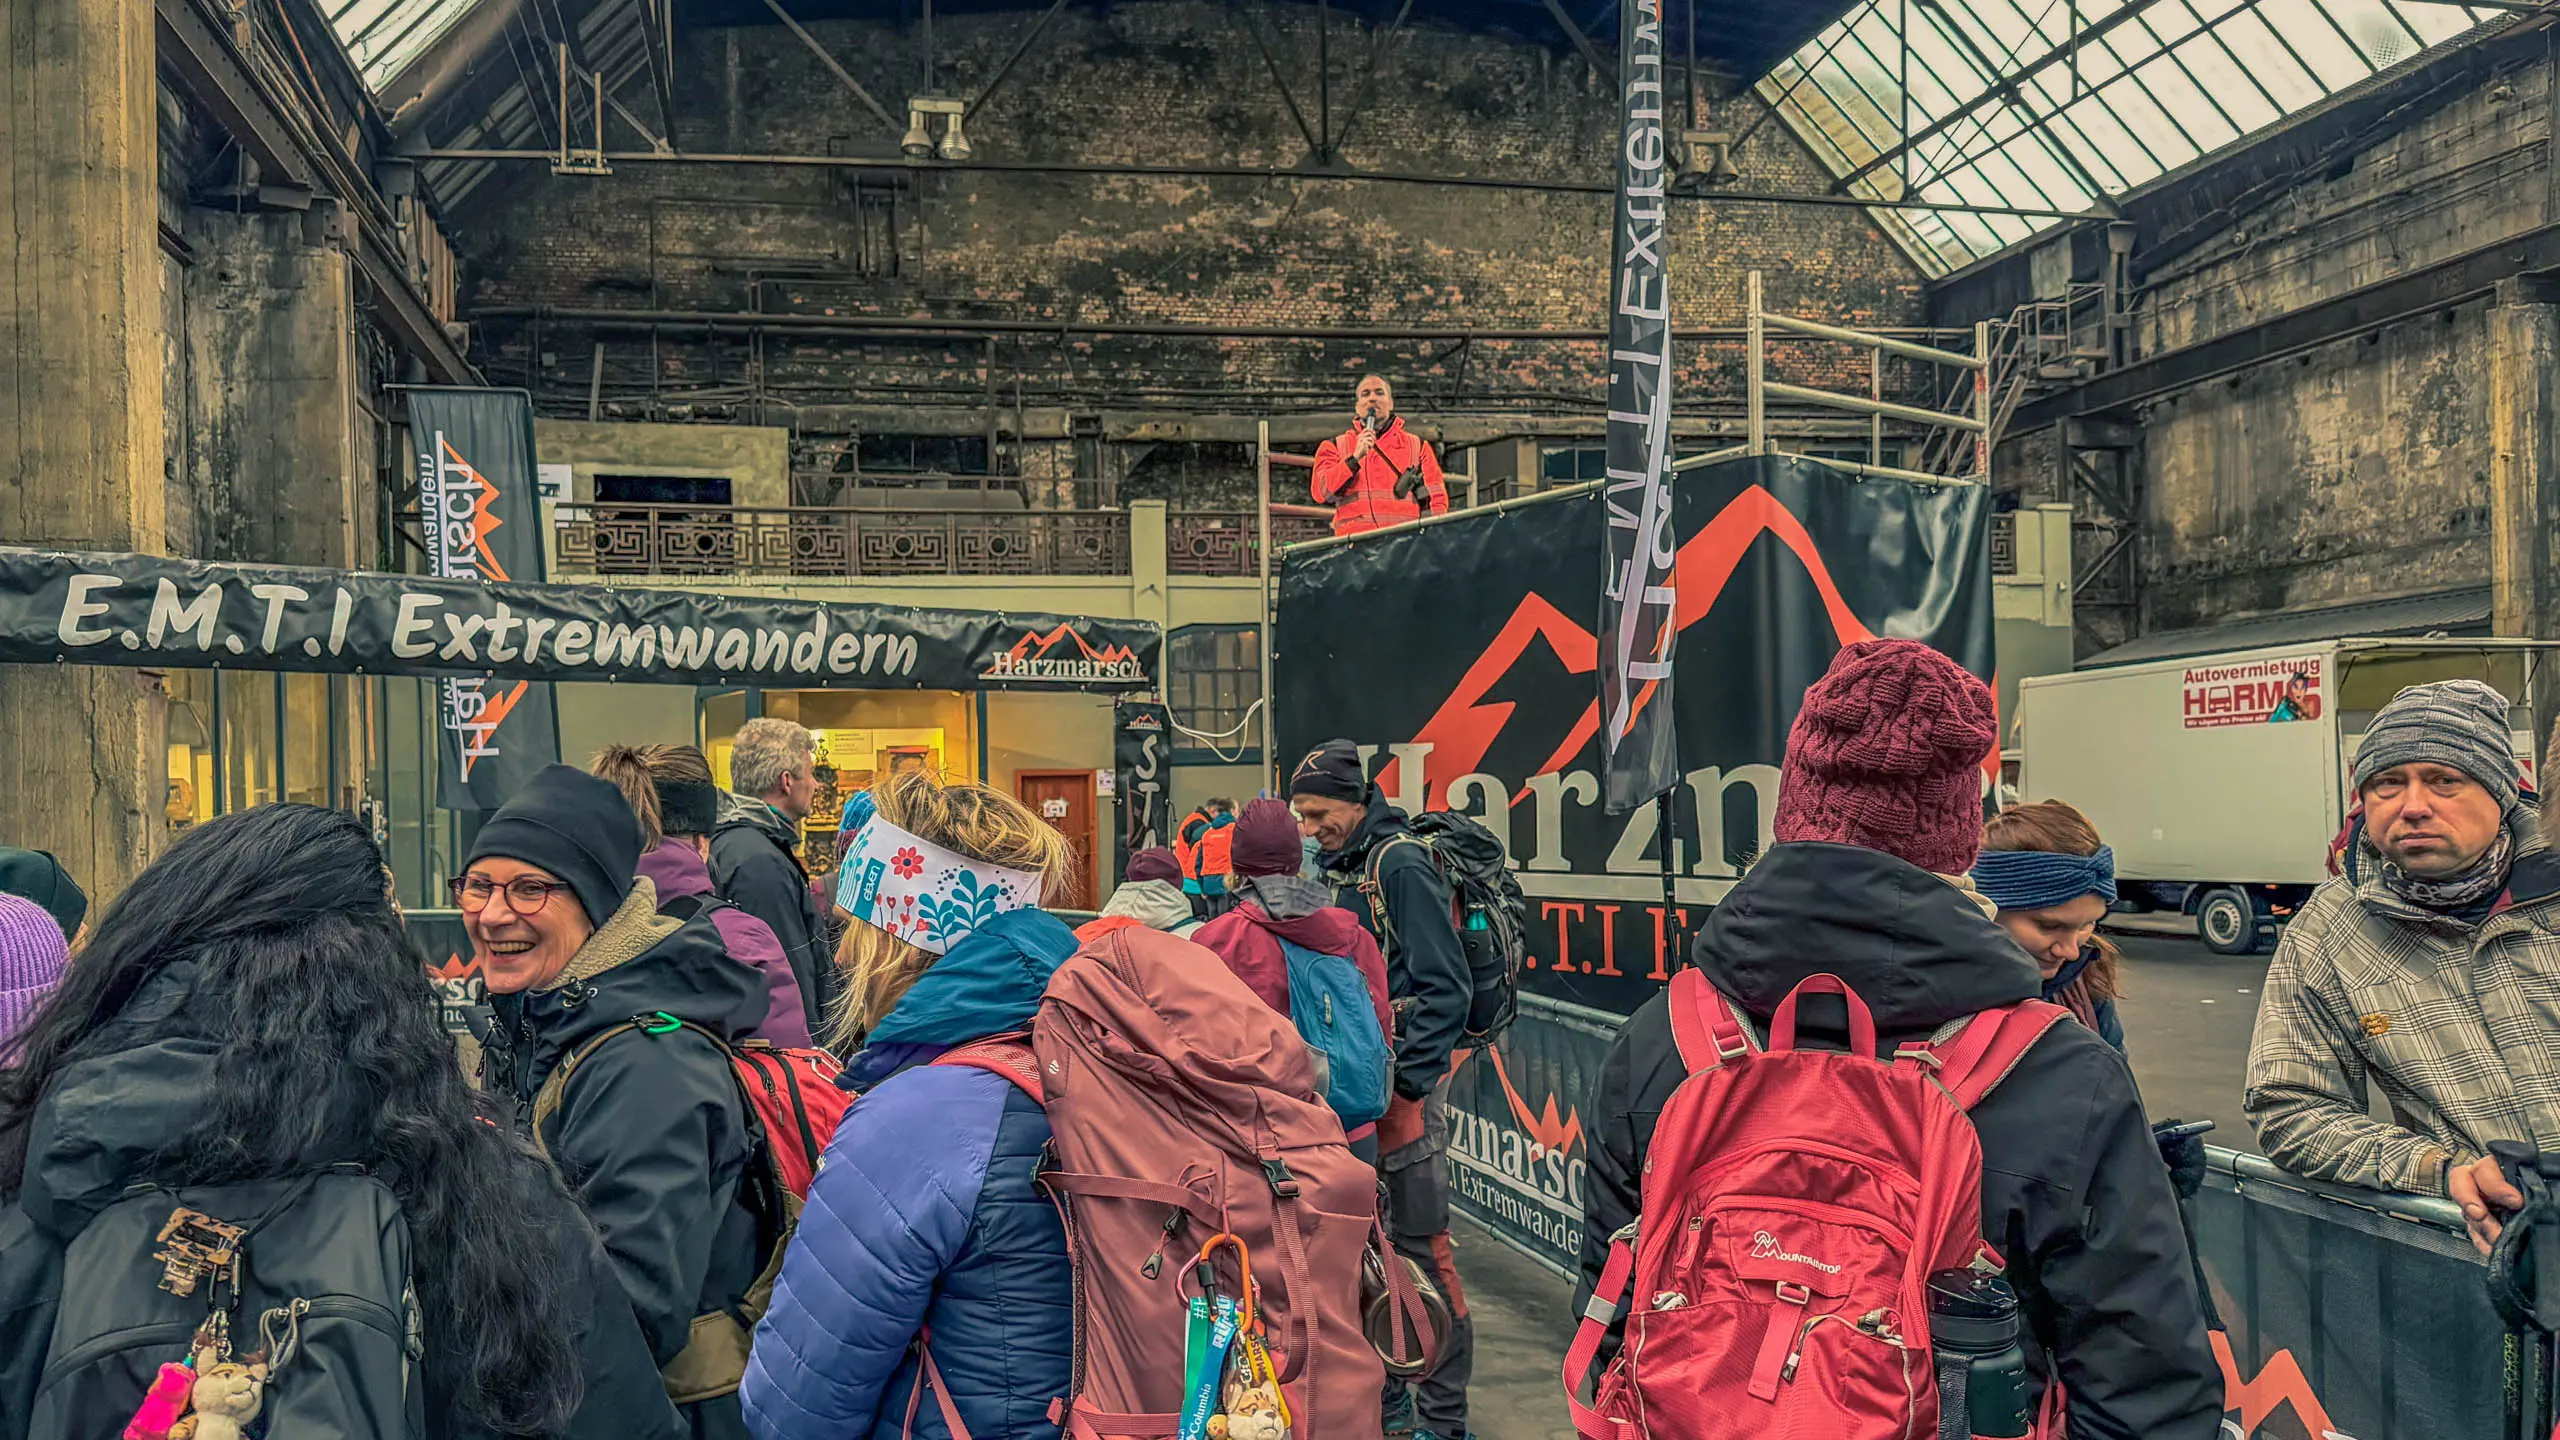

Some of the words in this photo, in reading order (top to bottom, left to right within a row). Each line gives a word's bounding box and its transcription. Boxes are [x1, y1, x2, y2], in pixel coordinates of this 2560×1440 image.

[58, 574, 352, 656] E.M.T.I
[392, 593, 918, 677] Extremwandern
[992, 652, 1141, 678] Harzmarsch
[2184, 659, 2320, 684] Autovermietung
[1189, 1383, 1212, 1434] Columbia
